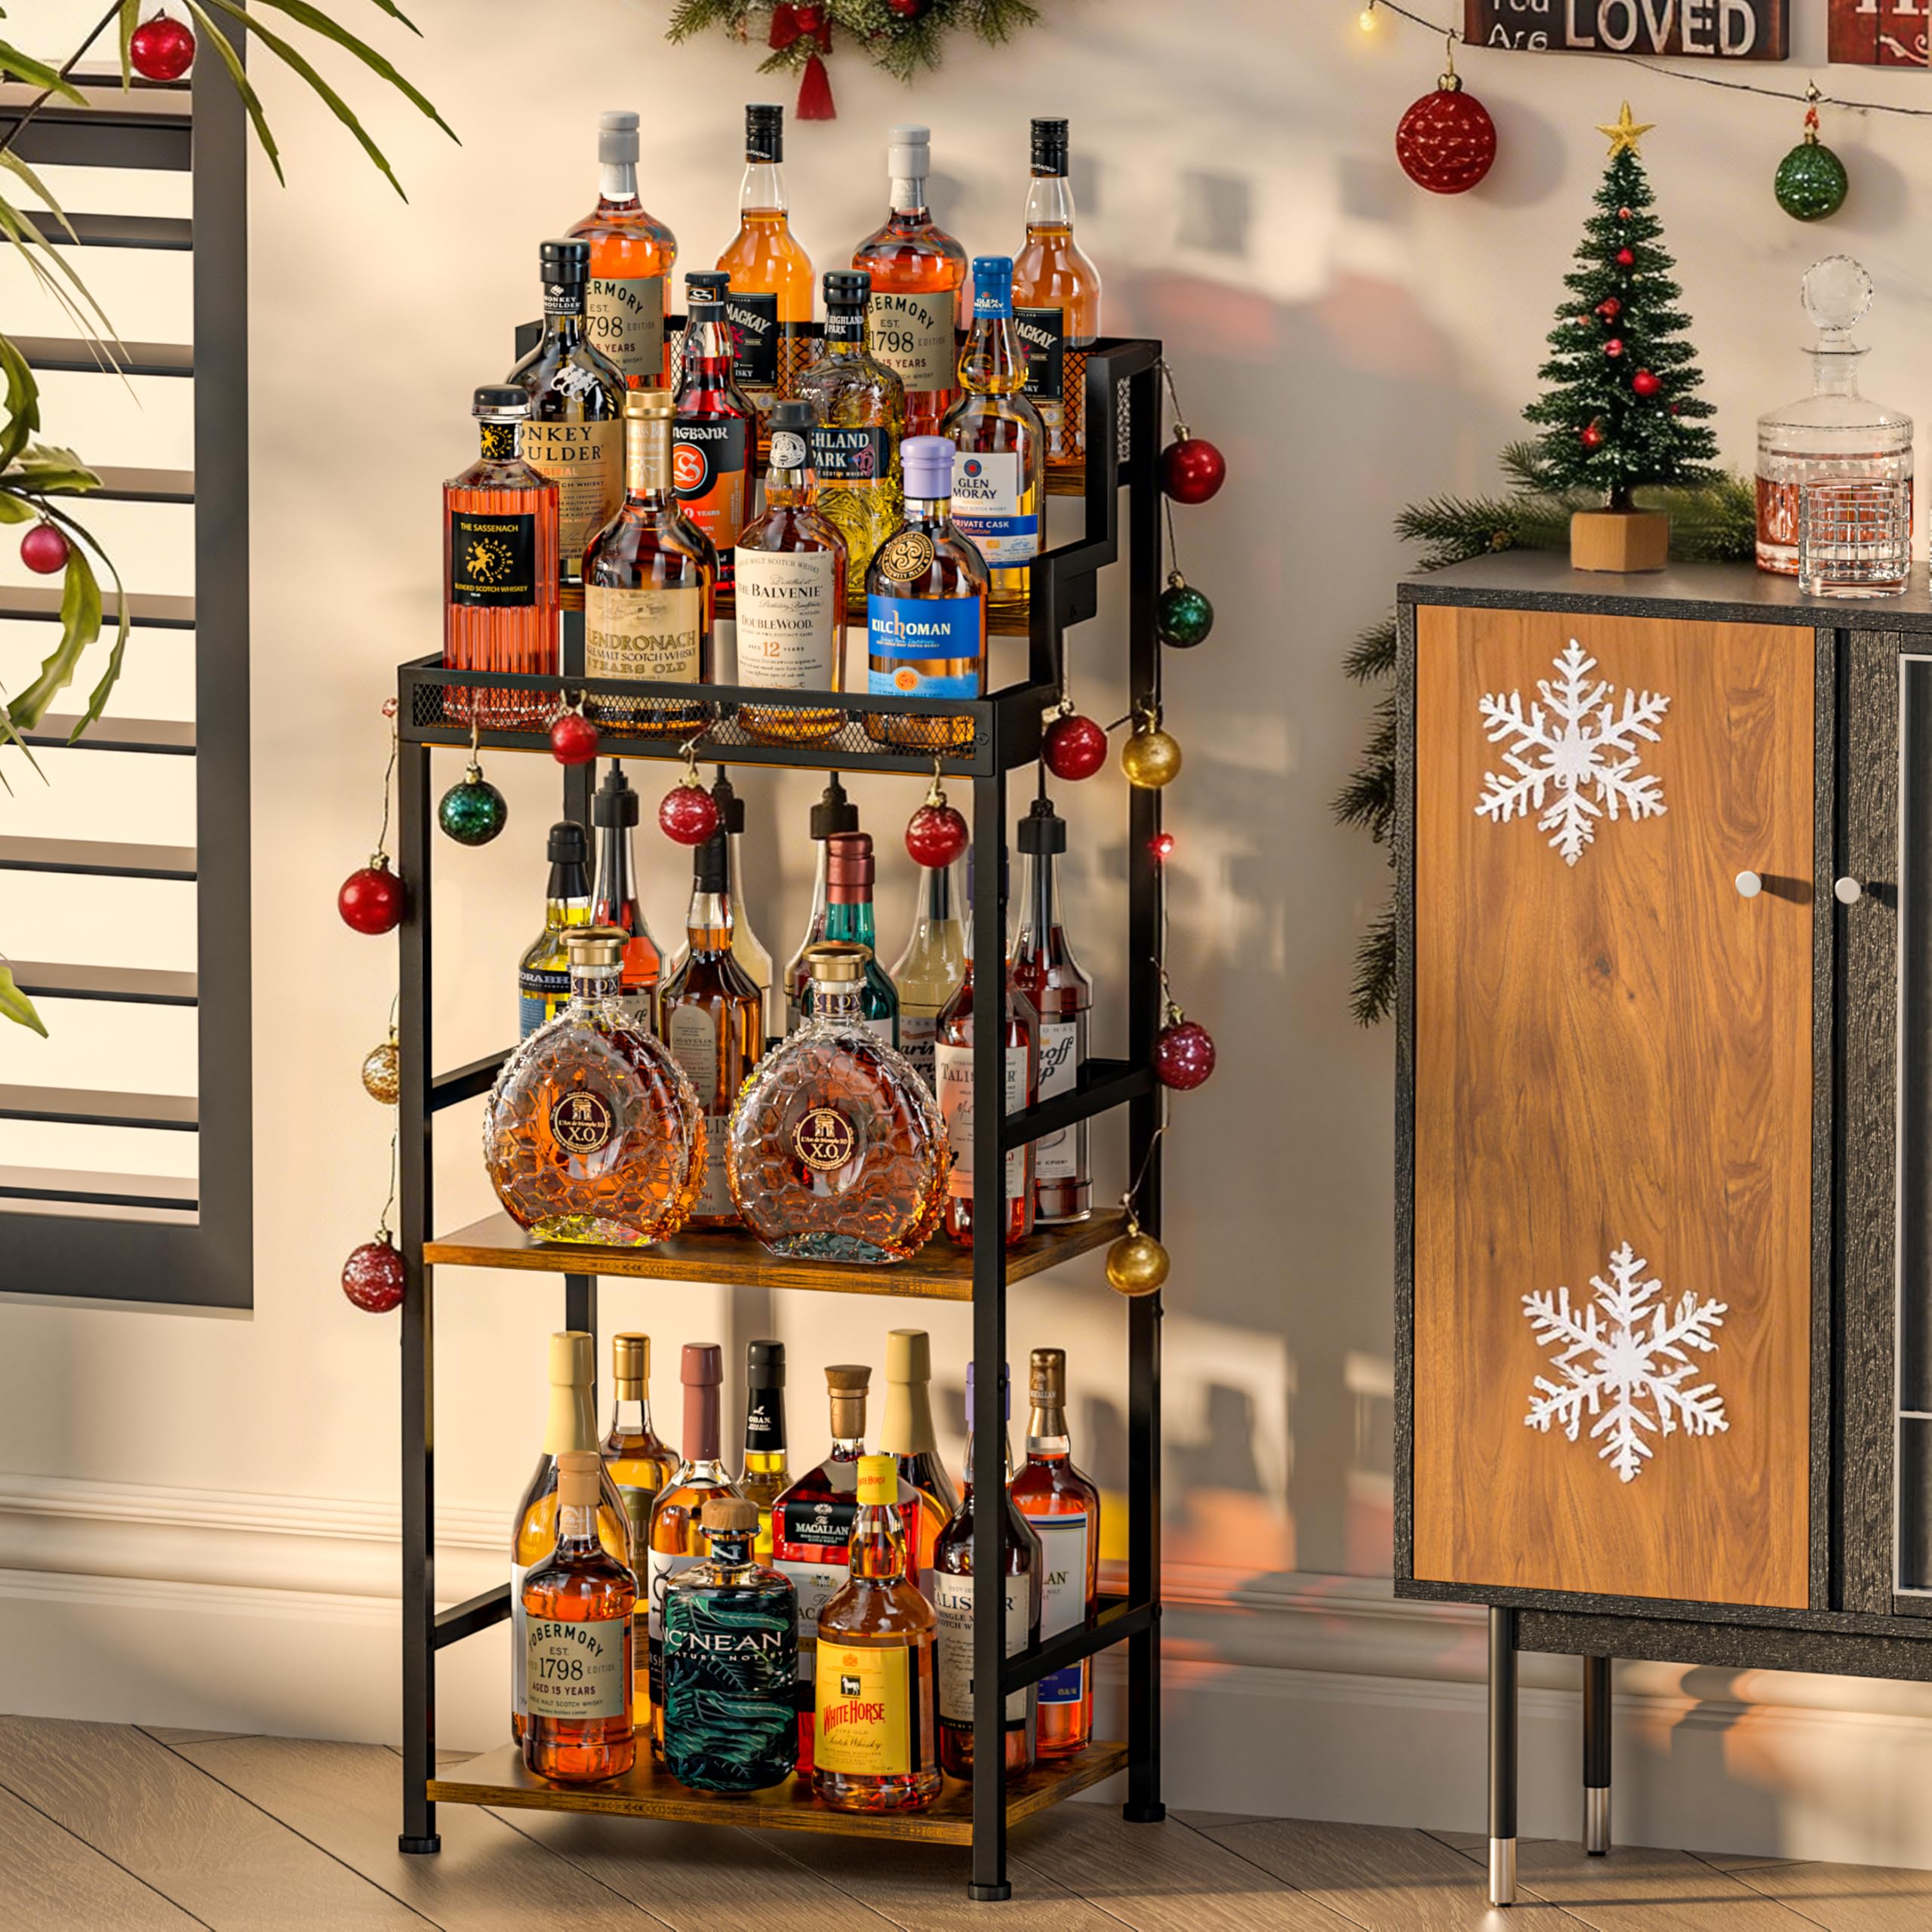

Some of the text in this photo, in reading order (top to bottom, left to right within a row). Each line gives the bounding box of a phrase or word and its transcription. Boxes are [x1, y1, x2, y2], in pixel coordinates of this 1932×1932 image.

[1565, 0, 1756, 55] LOVED
[586, 280, 644, 315] ERMORY
[829, 315, 864, 325] HIGHLAND
[868, 295, 934, 331] BERMORY
[586, 316, 623, 338] 798
[828, 325, 847, 334] PARK
[605, 343, 635, 352] YEARS
[869, 331, 914, 353] 1798
[895, 358, 927, 368] YEARS
[812, 451, 848, 468] ARK
[958, 477, 989, 489] GLEN
[952, 488, 998, 500] MORAY
[460, 522, 518, 533] THE SASSENACH
[768, 558, 795, 568] SCOTCH
[752, 583, 821, 598] BALVENIE
[597, 650, 620, 660] MALT
[621, 652, 663, 662] SCOTCH
[763, 641, 781, 658] 12
[592, 658, 688, 675] YEARS OLD
[521, 971, 572, 985] ORABH
[568, 1126, 598, 1143] X.O.
[810, 1143, 840, 1158] X.O.
[795, 1523, 850, 1536] MACALLAN
[528, 1623, 604, 1658] TOBERMORY
[549, 1647, 569, 1656] EST.
[729, 1653, 760, 1662] NOT
[539, 1657, 583, 1681] 1798
[533, 1682, 595, 1696] AGED 15 YEARS
[823, 1700, 886, 1737] WHITE HORSE
